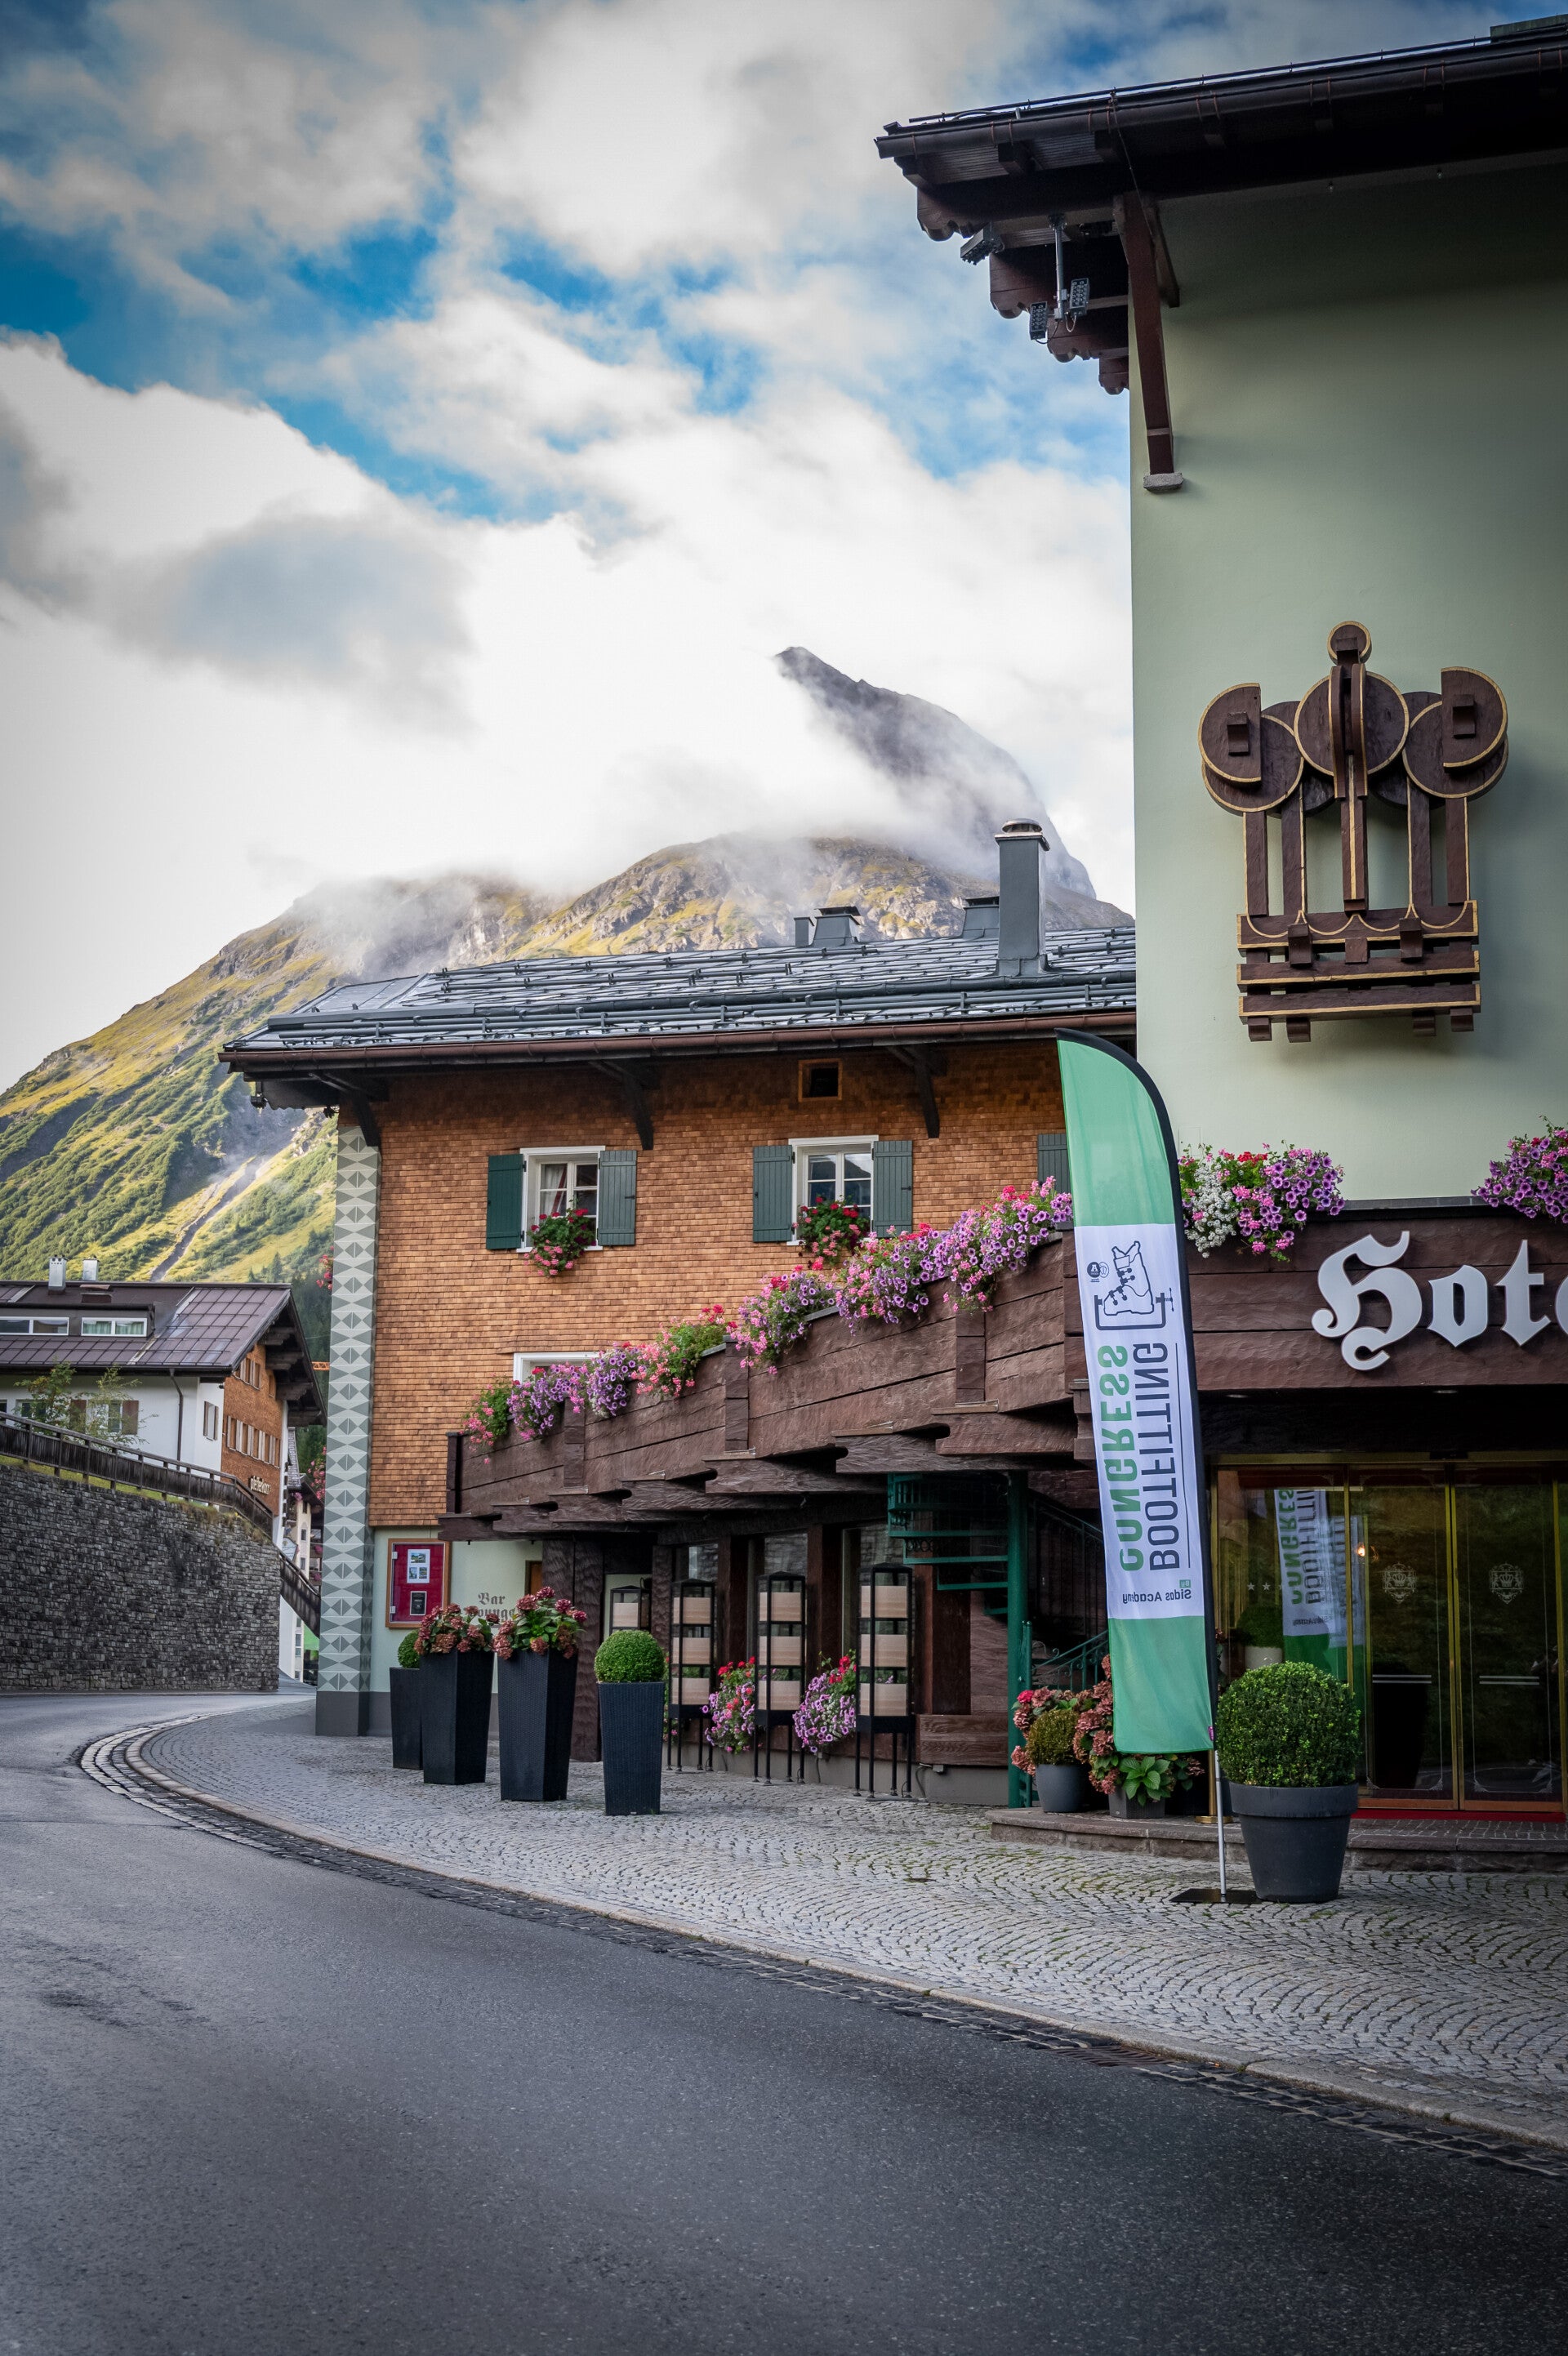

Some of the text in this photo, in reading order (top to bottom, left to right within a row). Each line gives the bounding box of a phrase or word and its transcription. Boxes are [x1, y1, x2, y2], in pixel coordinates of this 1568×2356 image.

[1312, 1230, 1568, 1371] Hot
[478, 1592, 506, 1606] Bar
[477, 1608, 515, 1621] ounge
